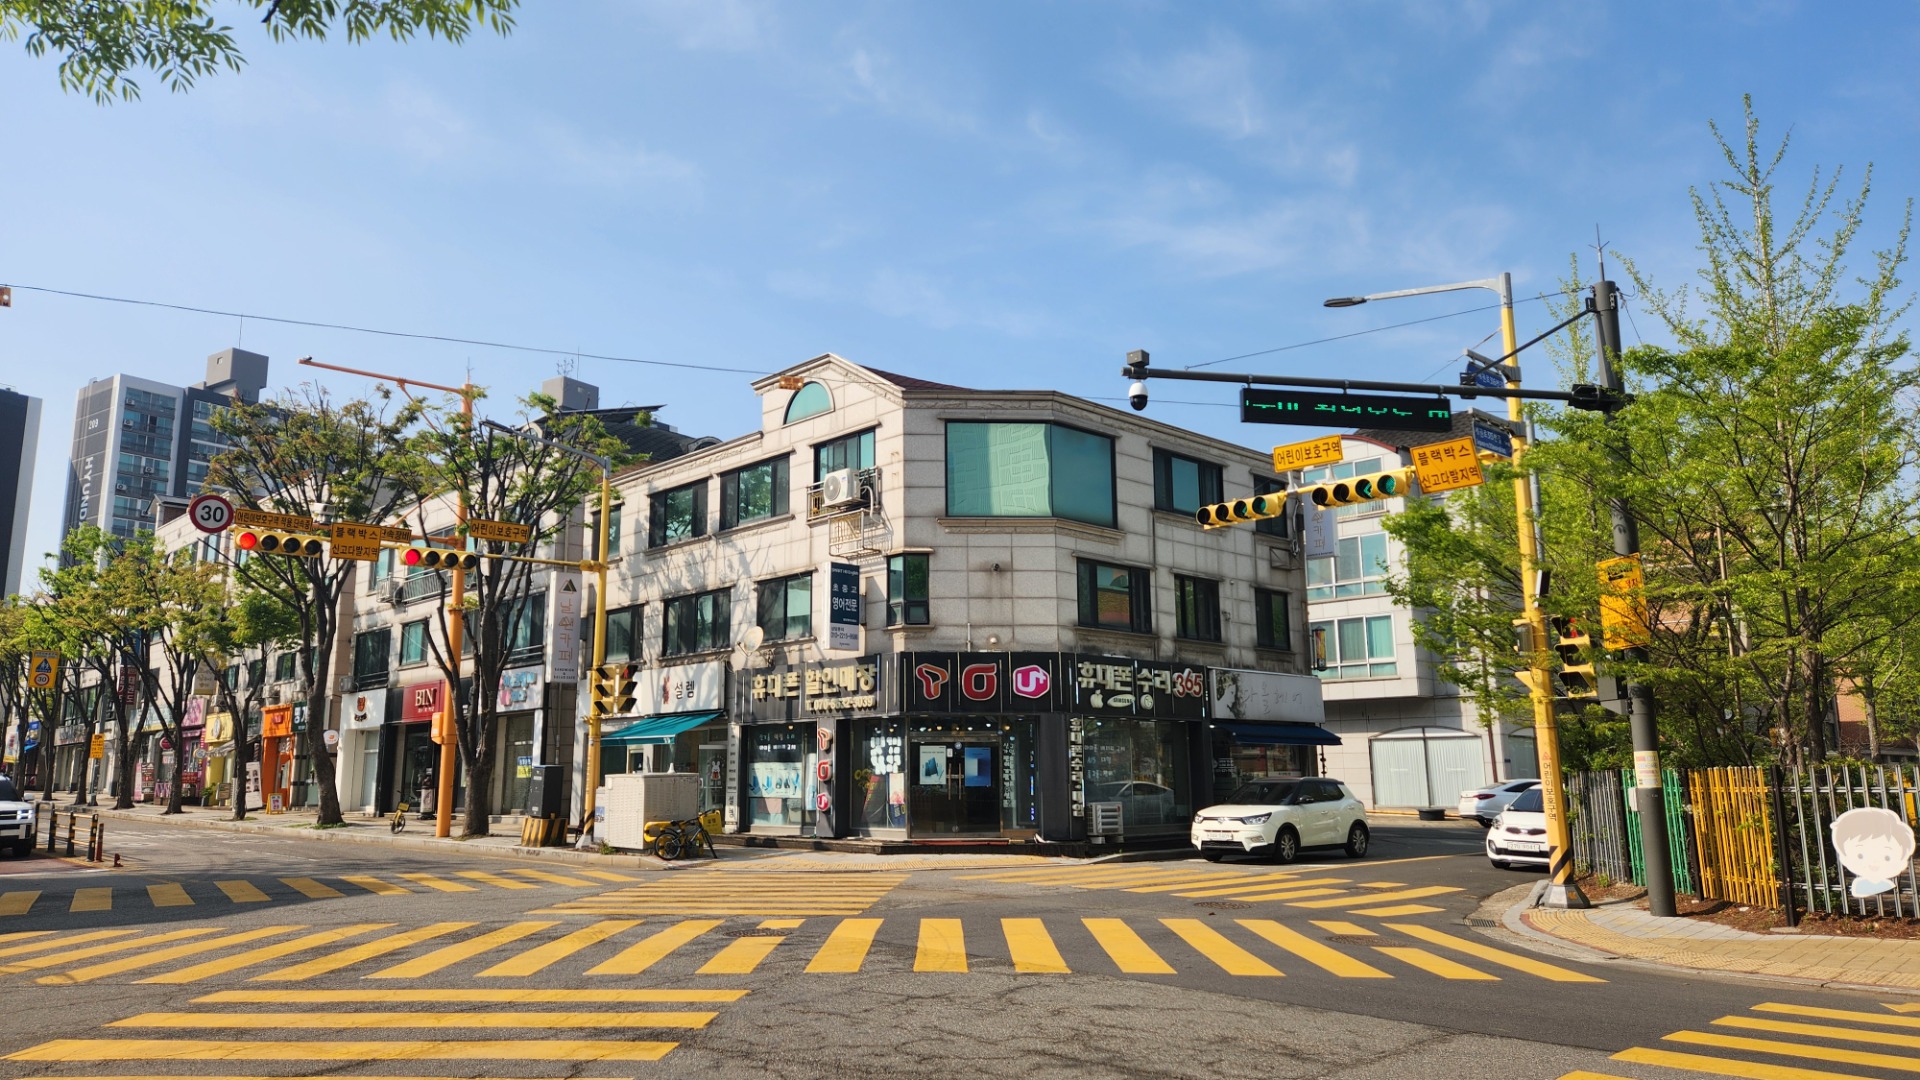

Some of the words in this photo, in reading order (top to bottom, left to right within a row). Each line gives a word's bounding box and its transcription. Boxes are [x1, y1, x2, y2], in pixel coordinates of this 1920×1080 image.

[1276, 440, 1342, 466] 어린이보호구역
[1416, 445, 1472, 467] 블랙박스
[1420, 466, 1481, 489] 신고다발지역
[79, 456, 94, 523] HYUND
[200, 505, 224, 522] 30
[238, 512, 279, 526] 어린이보호구역
[336, 526, 378, 540] 블랙박스
[470, 524, 529, 540] 어린이보호구역
[332, 544, 378, 558] 신고다발지역
[832, 596, 858, 612] 영어전문
[752, 671, 800, 699] 휴대폰
[805, 664, 878, 695] 할인매장
[1078, 661, 1132, 692] 휴대폰
[1137, 668, 1172, 694] 수리
[1172, 668, 1204, 698] 365
[415, 688, 434, 707] BIN
[674, 680, 695, 700] 설렘
[1543, 762, 1556, 821] 어린이보호구역
